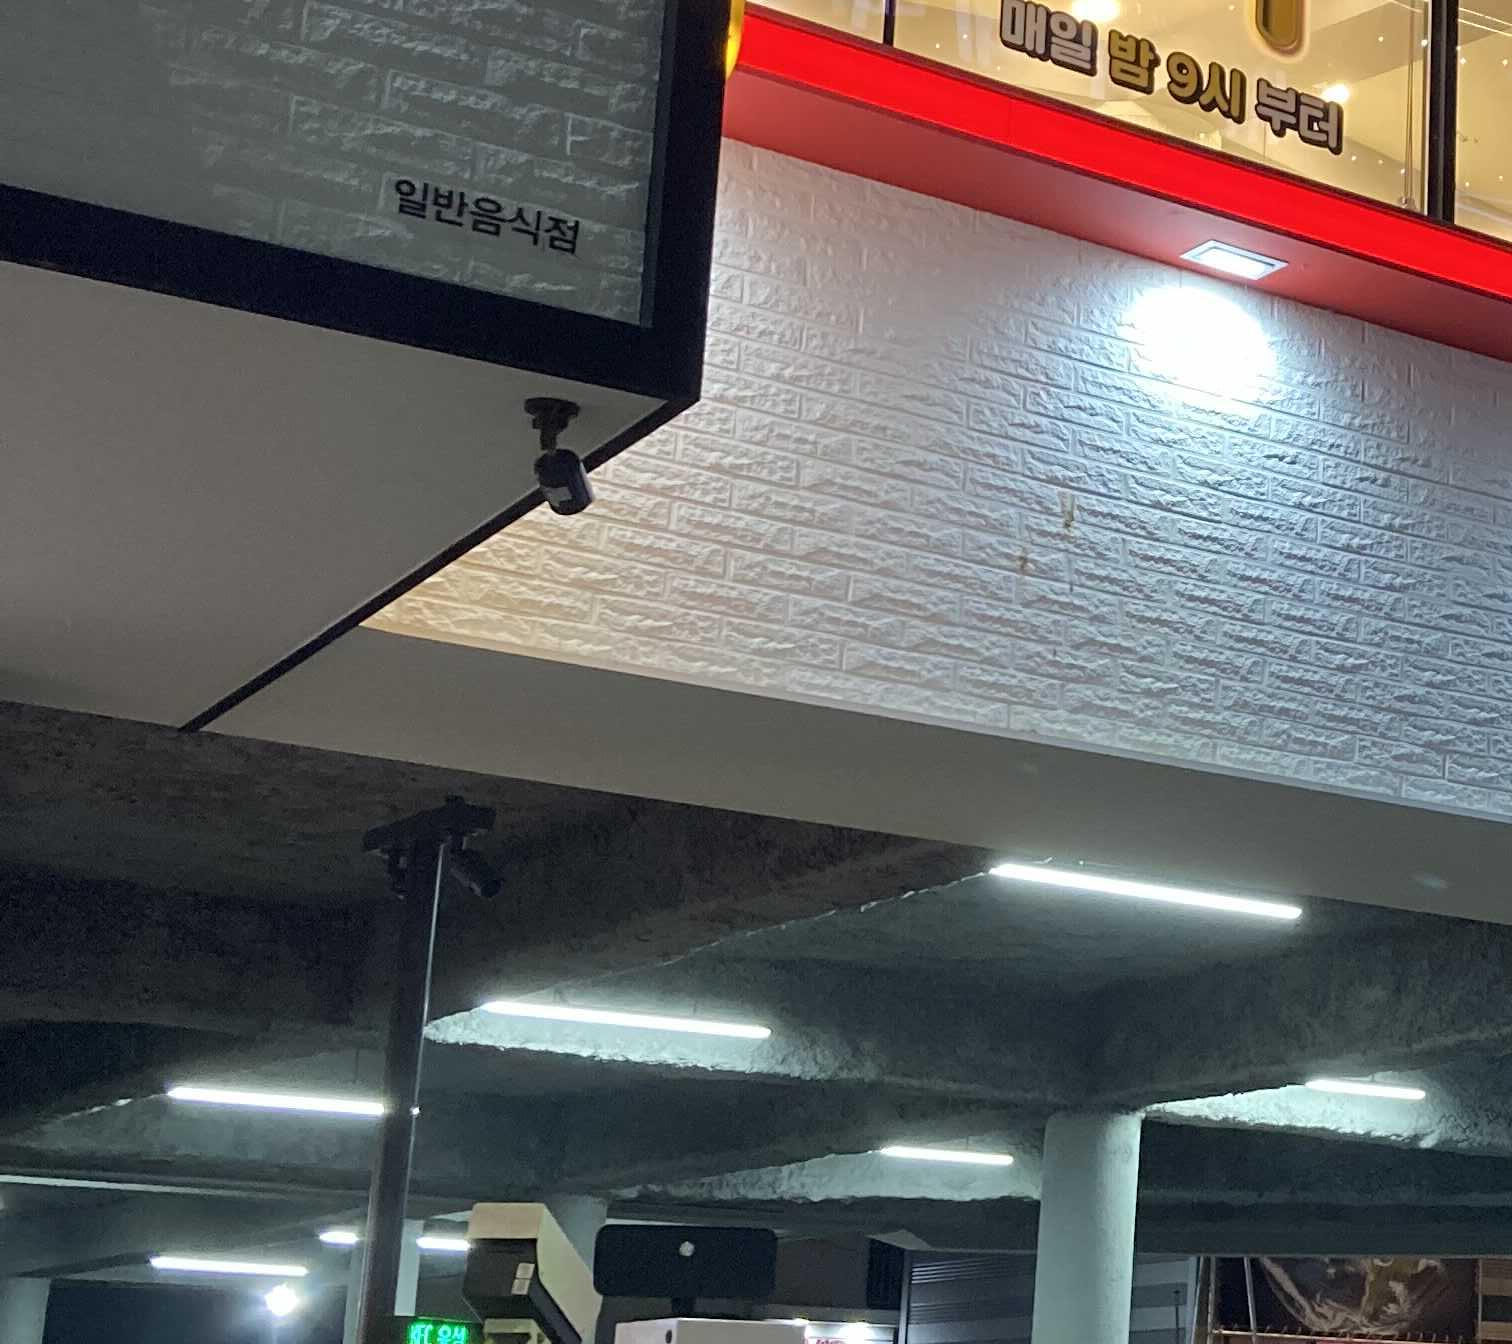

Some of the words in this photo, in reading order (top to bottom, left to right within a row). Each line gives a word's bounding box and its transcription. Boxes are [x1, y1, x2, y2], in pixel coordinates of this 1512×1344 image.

[1106, 29, 1160, 89] 밤
[1167, 53, 1247, 124] 9시
[1253, 78, 1344, 155] 부터
[393, 177, 583, 258] 일반음식점
